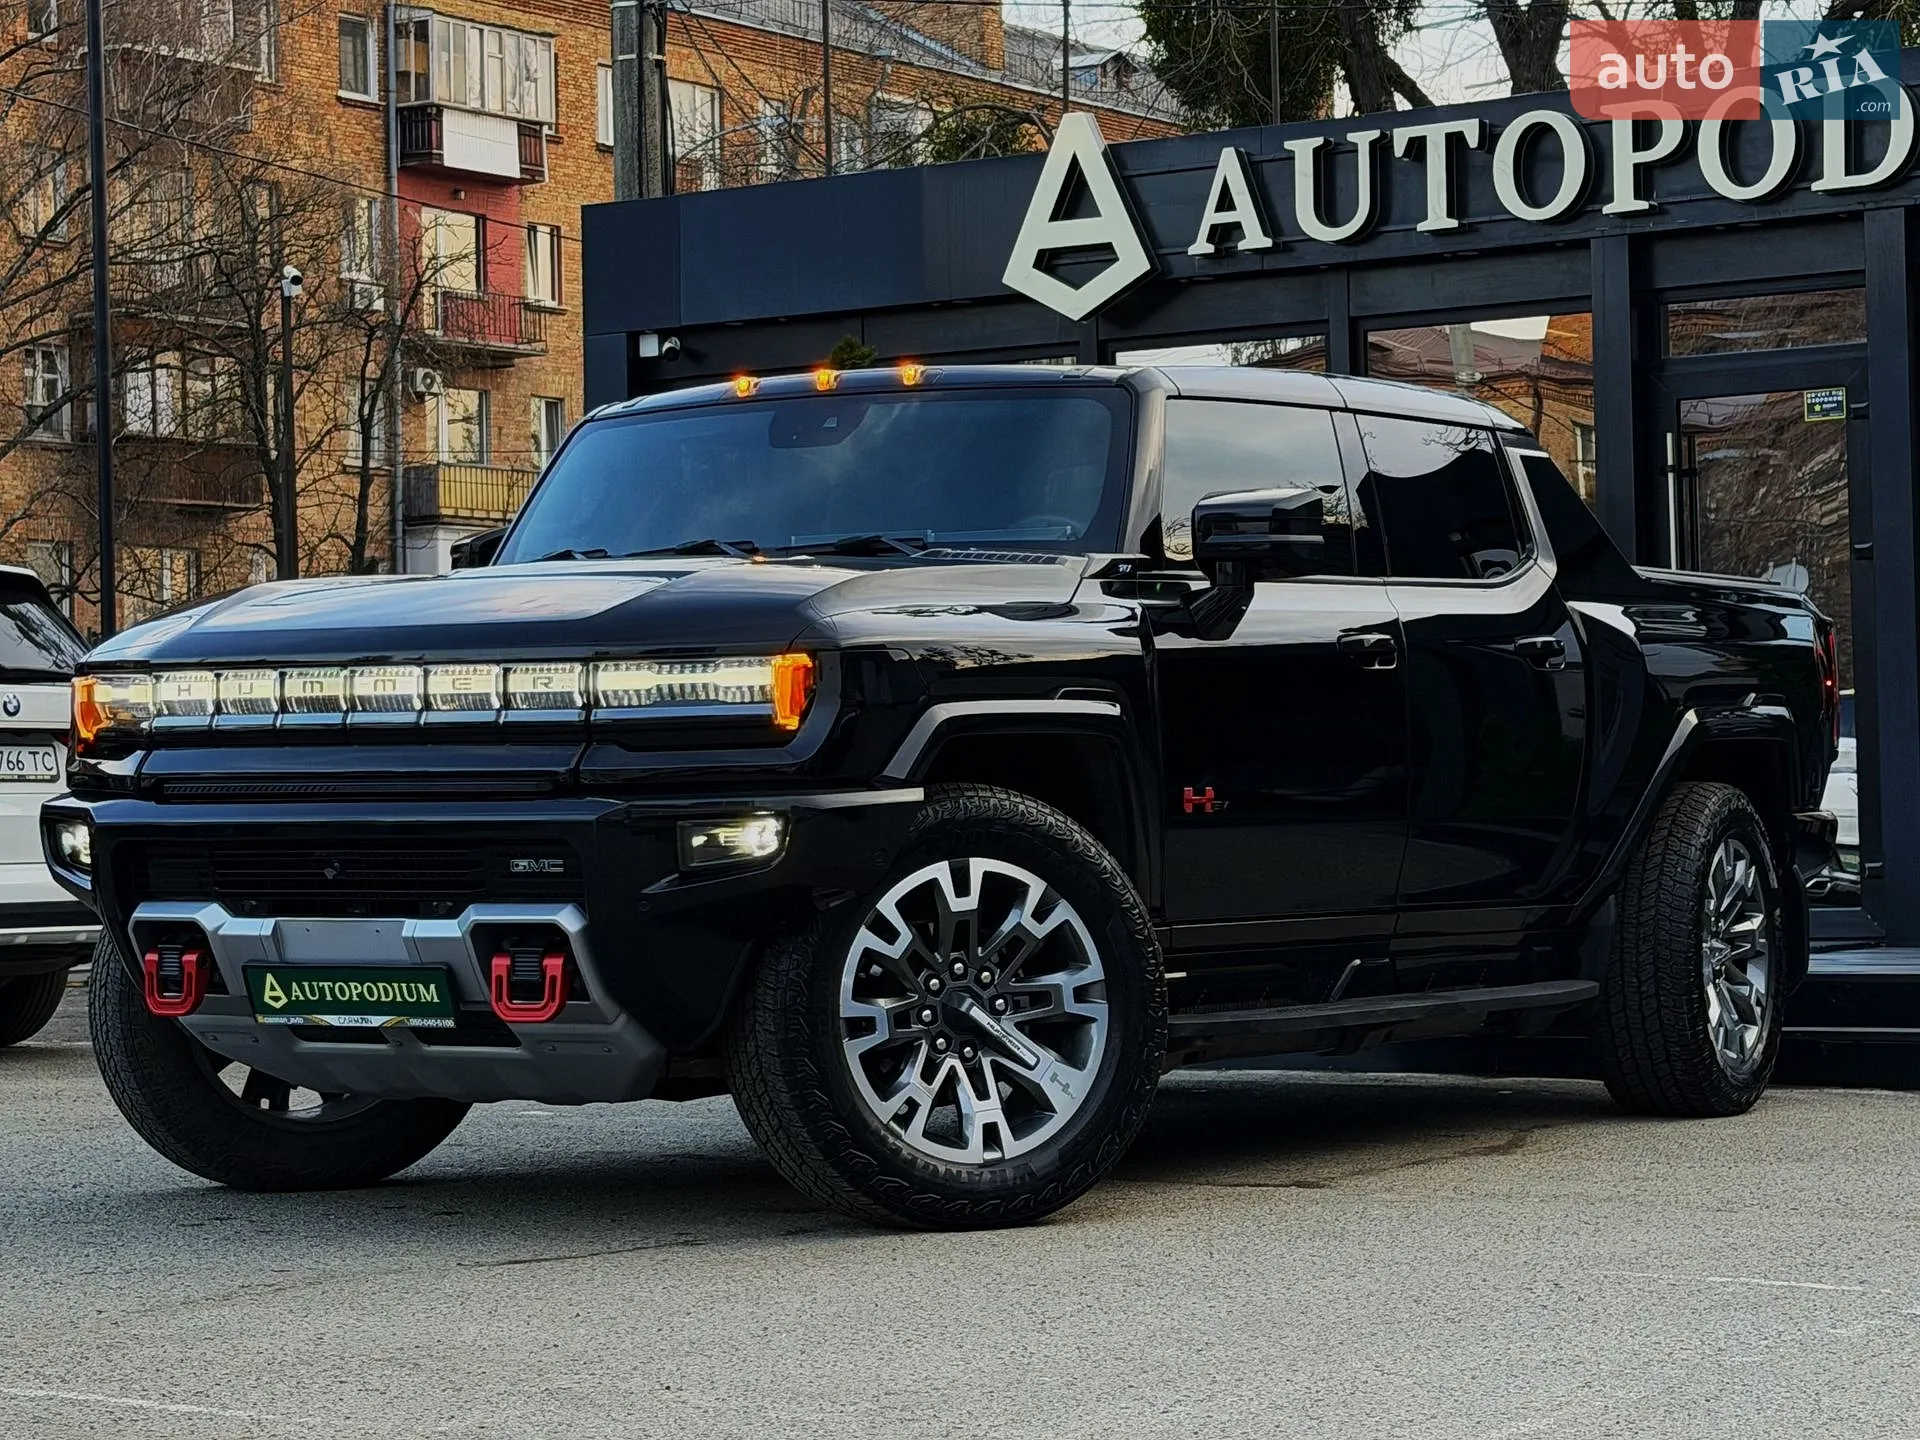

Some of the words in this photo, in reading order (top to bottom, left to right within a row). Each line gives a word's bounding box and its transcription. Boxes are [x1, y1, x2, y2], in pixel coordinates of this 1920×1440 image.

[1188, 76, 1914, 256] AUTOPOD
[510, 859, 564, 872] GMC
[291, 982, 440, 1003] AUTOPODIUM
